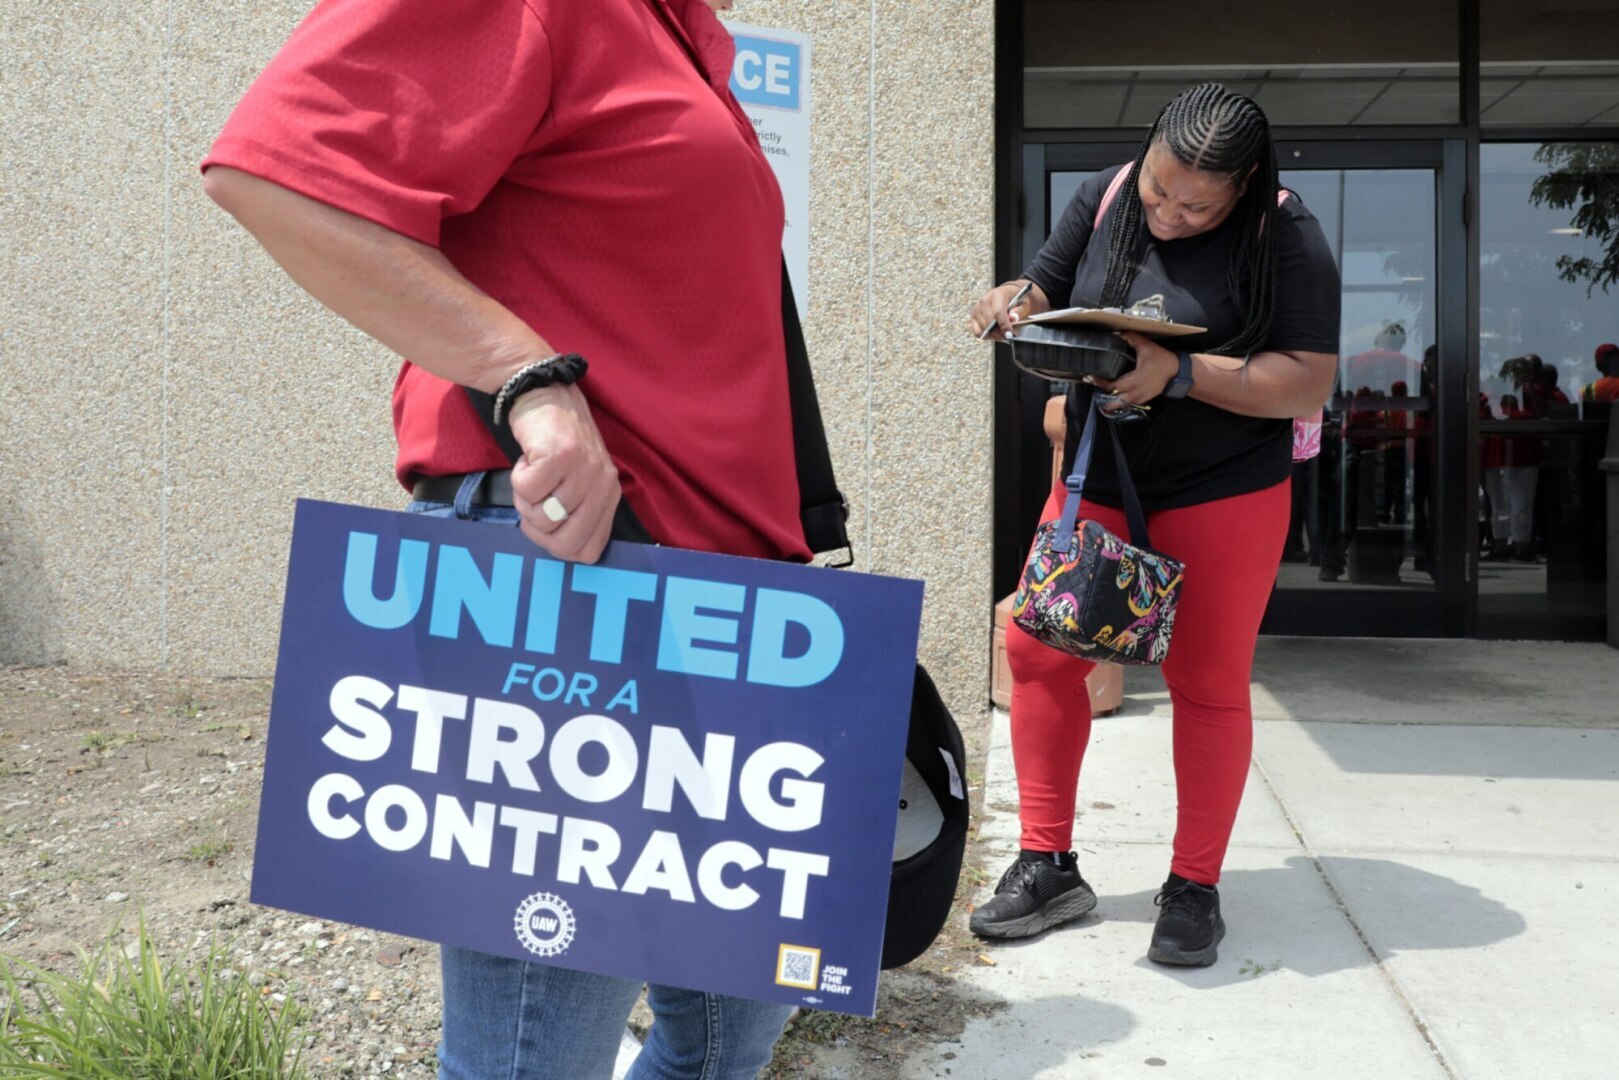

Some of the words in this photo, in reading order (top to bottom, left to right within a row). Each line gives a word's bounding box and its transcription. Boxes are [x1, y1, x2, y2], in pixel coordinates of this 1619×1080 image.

[343, 531, 845, 688] UNITED
[502, 662, 597, 707] FOR
[606, 679, 638, 714] A
[320, 675, 826, 833] STRONG
[307, 772, 830, 920] CONTRACT
[531, 915, 558, 933] UAW
[820, 982, 852, 995] FIGHT
[822, 965, 848, 977] JOIN
[822, 974, 843, 985] THE
